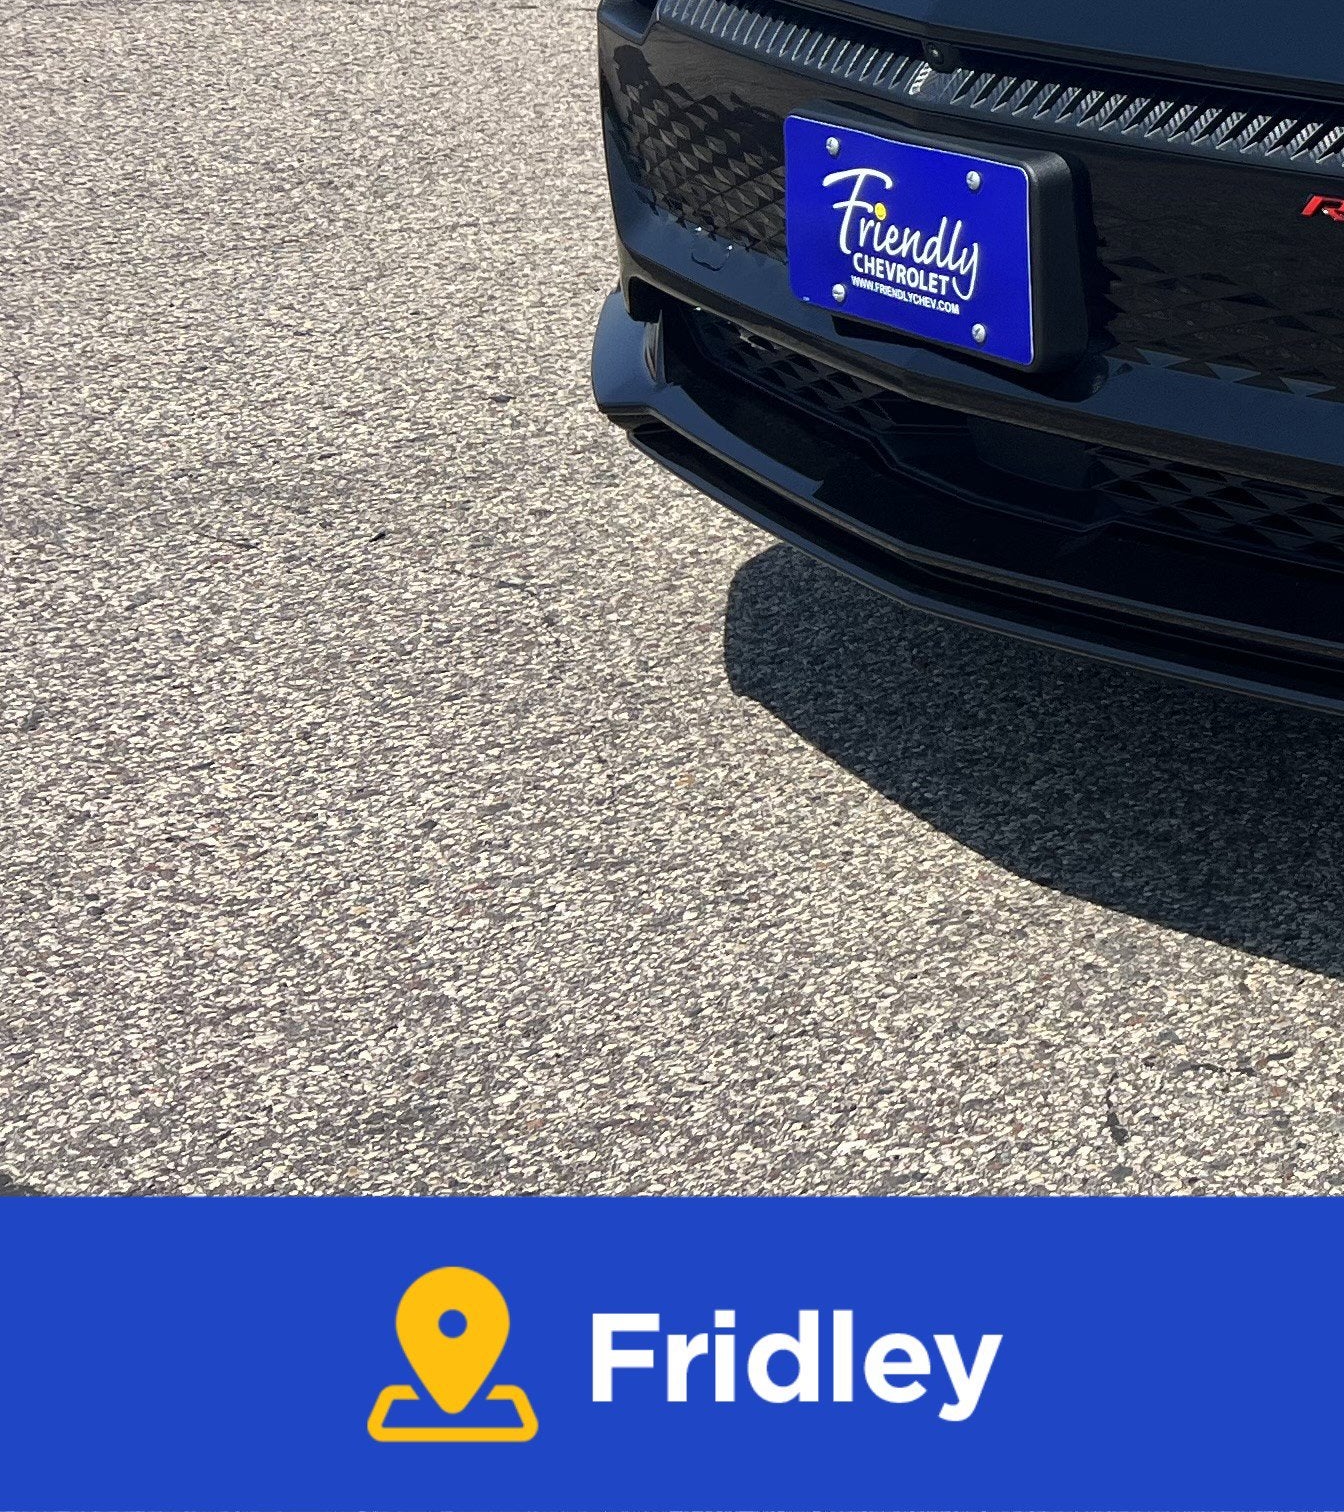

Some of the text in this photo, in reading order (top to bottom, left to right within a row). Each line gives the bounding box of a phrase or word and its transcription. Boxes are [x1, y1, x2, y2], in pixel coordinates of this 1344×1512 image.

[822, 168, 979, 300] Friendly
[850, 274, 960, 315] WWW.FRIENDLYCHEV.COM
[852, 251, 950, 296] CHEVROLET
